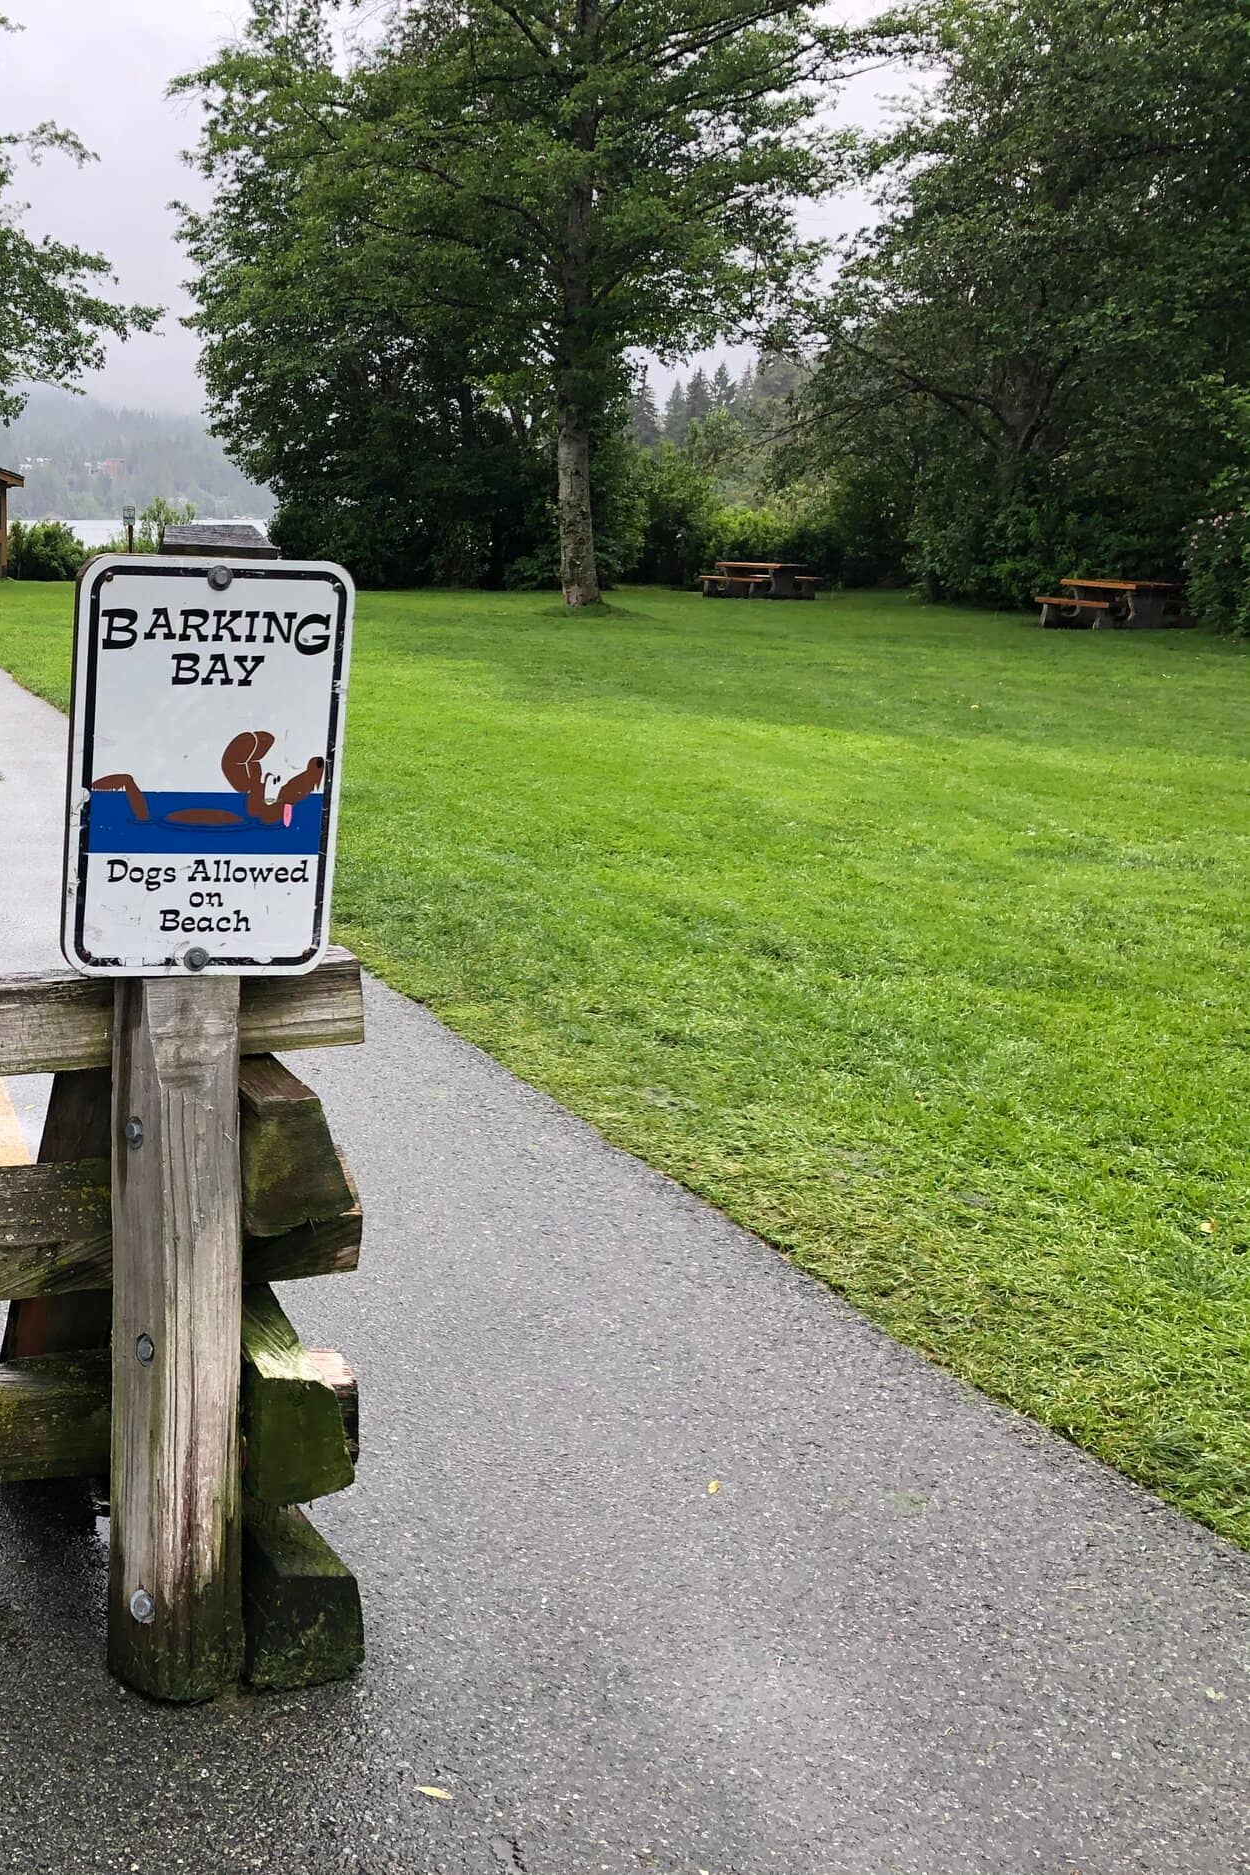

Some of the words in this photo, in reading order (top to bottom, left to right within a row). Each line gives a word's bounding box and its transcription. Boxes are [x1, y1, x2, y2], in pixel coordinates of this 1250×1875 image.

[101, 607, 332, 656] BARKING
[171, 653, 266, 687] BAY
[107, 859, 177, 892] Dogs
[187, 859, 309, 884] Allowed
[189, 891, 224, 908] on
[159, 908, 251, 933] Beach
